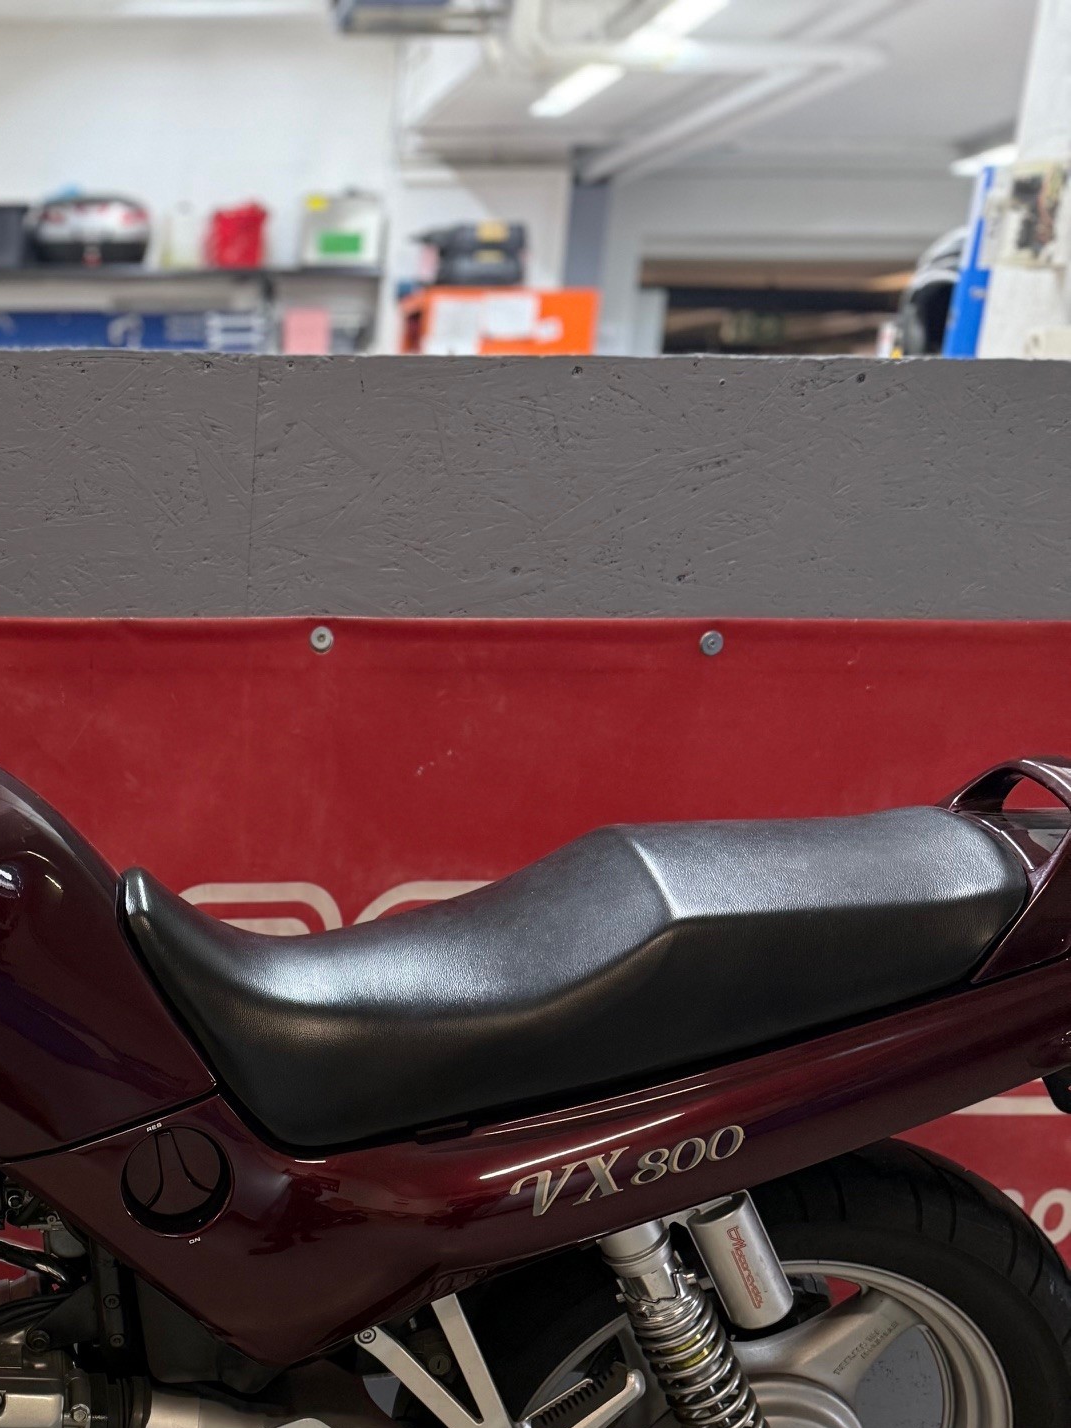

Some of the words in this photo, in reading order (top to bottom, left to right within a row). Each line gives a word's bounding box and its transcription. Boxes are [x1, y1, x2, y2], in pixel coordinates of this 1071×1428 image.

[146, 1122, 162, 1133] RES
[509, 1146, 630, 1217] VX
[630, 1125, 745, 1186] 800
